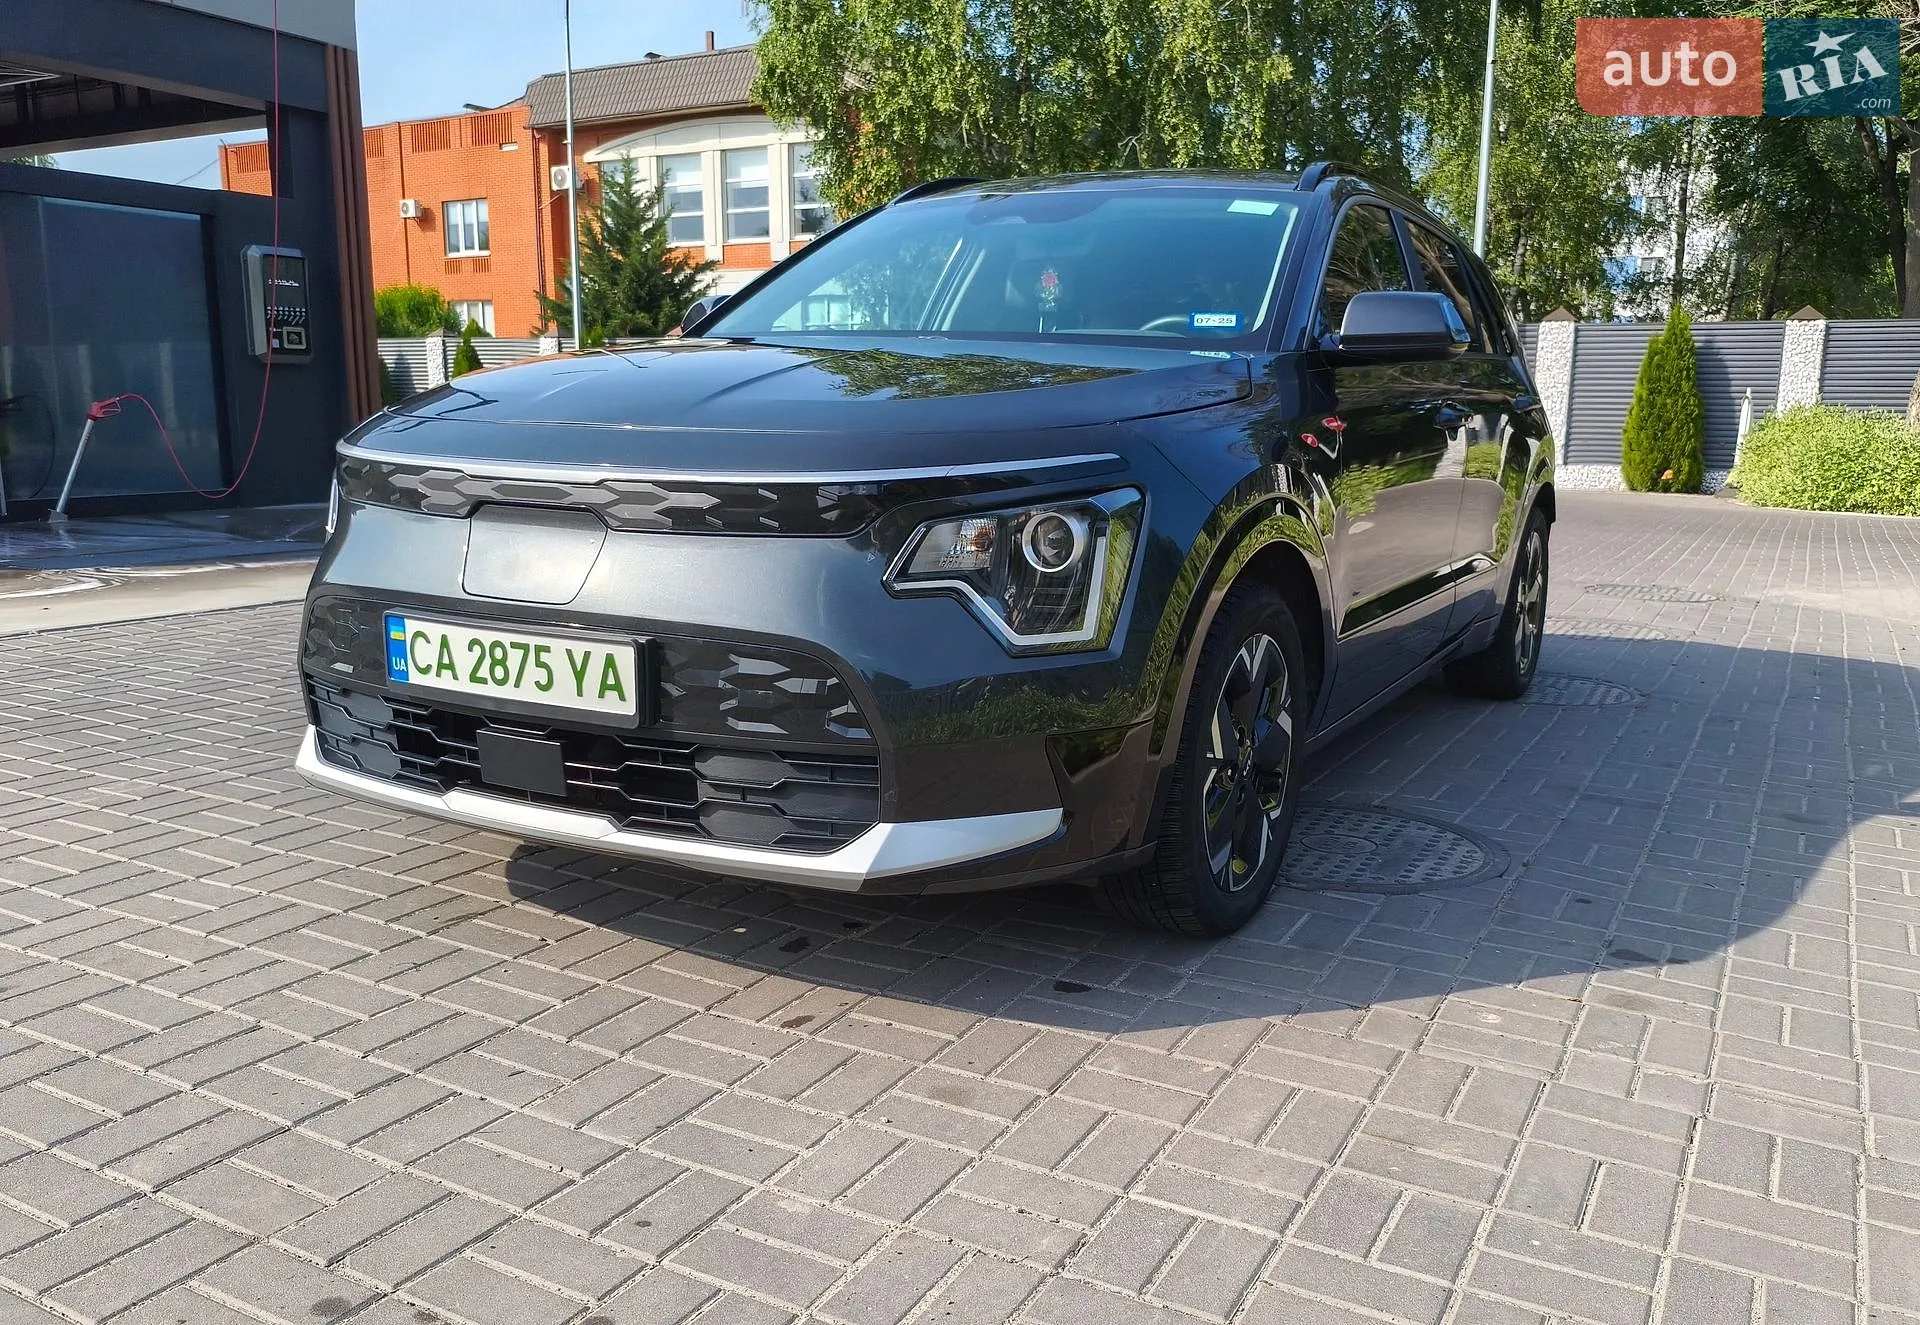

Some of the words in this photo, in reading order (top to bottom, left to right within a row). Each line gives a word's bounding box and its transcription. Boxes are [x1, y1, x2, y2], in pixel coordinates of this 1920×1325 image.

[393, 657, 407, 672] UA
[410, 631, 459, 681] CA
[468, 638, 554, 692] 2875
[565, 648, 626, 702] YA
